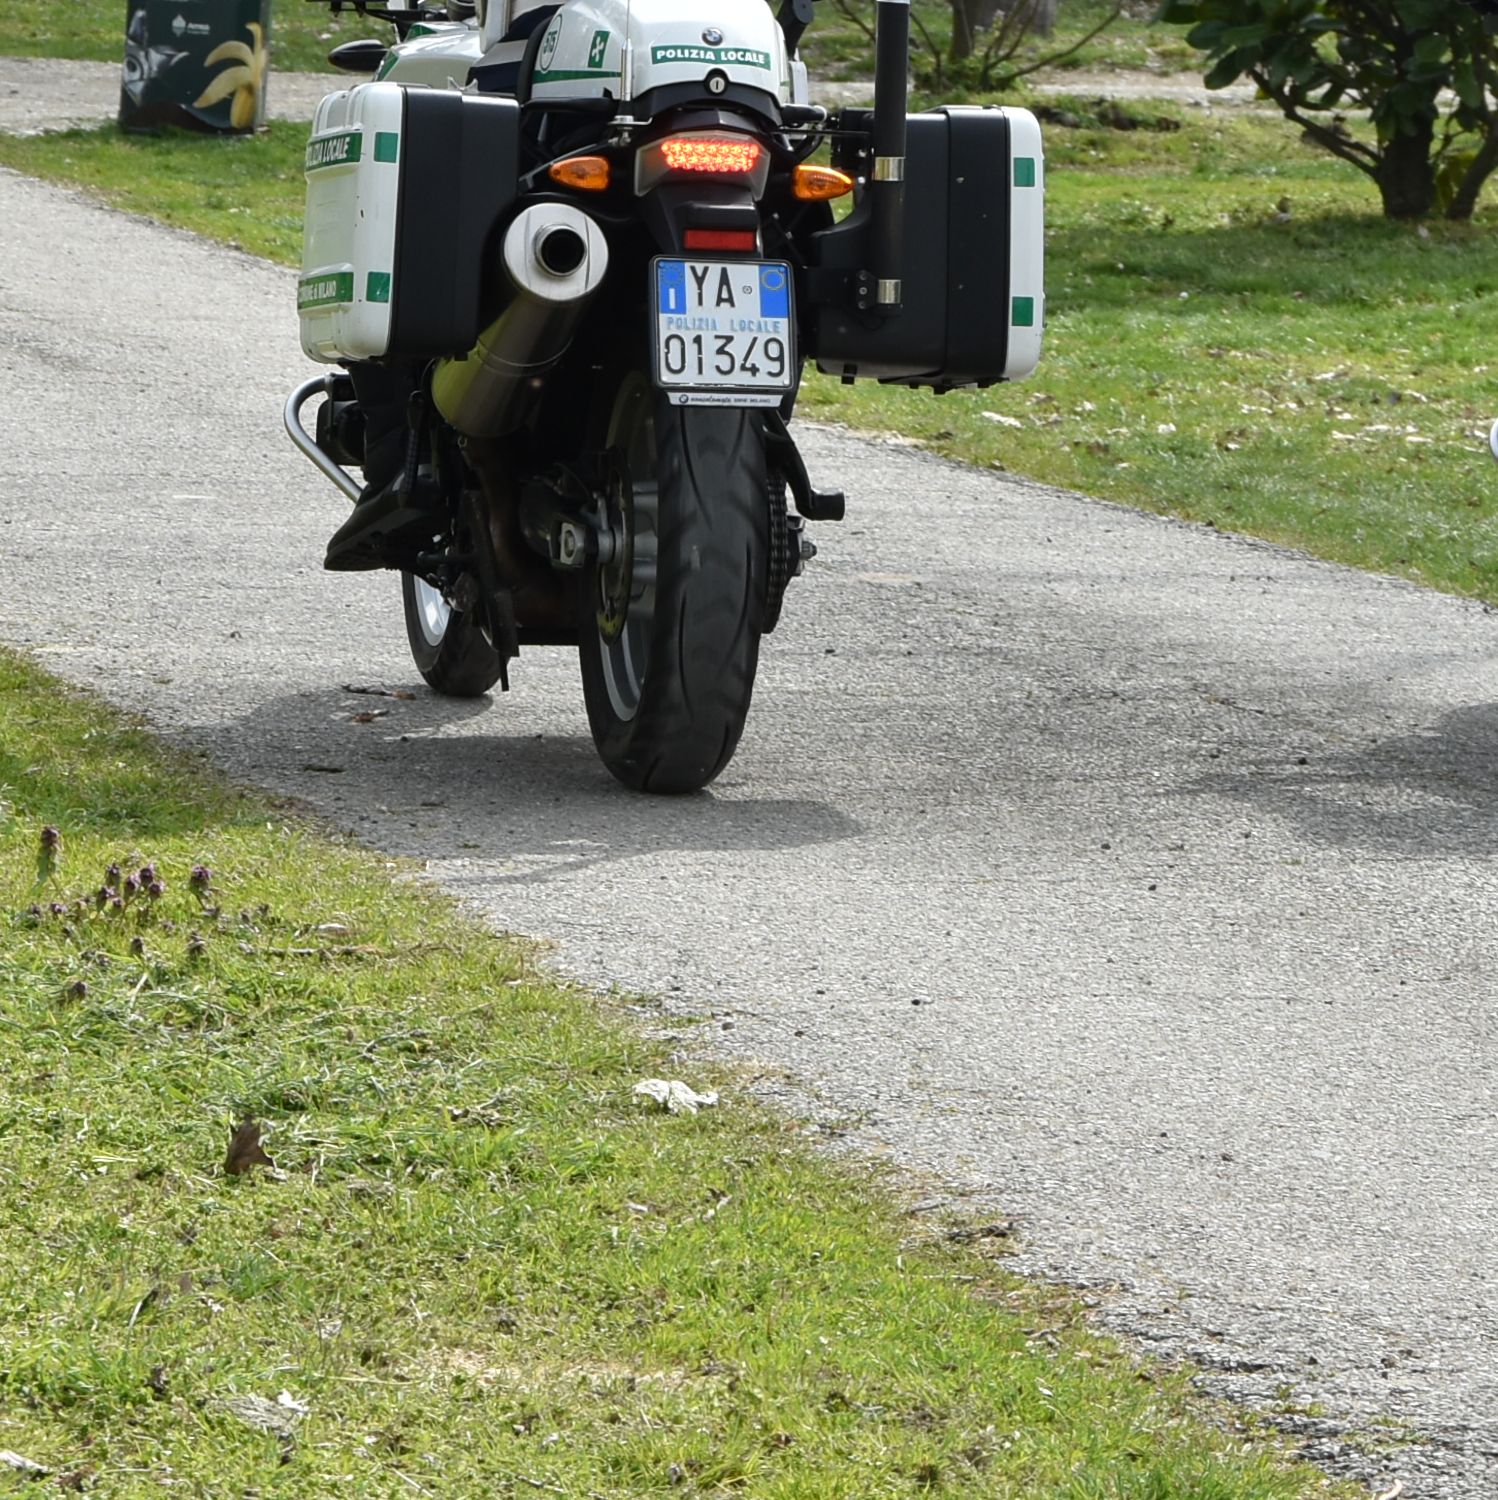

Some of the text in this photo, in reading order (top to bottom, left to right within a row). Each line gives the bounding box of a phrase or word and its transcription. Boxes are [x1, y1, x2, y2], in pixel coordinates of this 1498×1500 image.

[656, 48, 765, 64] POLIZIA LOCALE
[323, 136, 351, 163] LOCALE
[689, 265, 736, 308] YA
[667, 317, 781, 334] POLIZIA LOCALE
[664, 334, 785, 378] 01349
